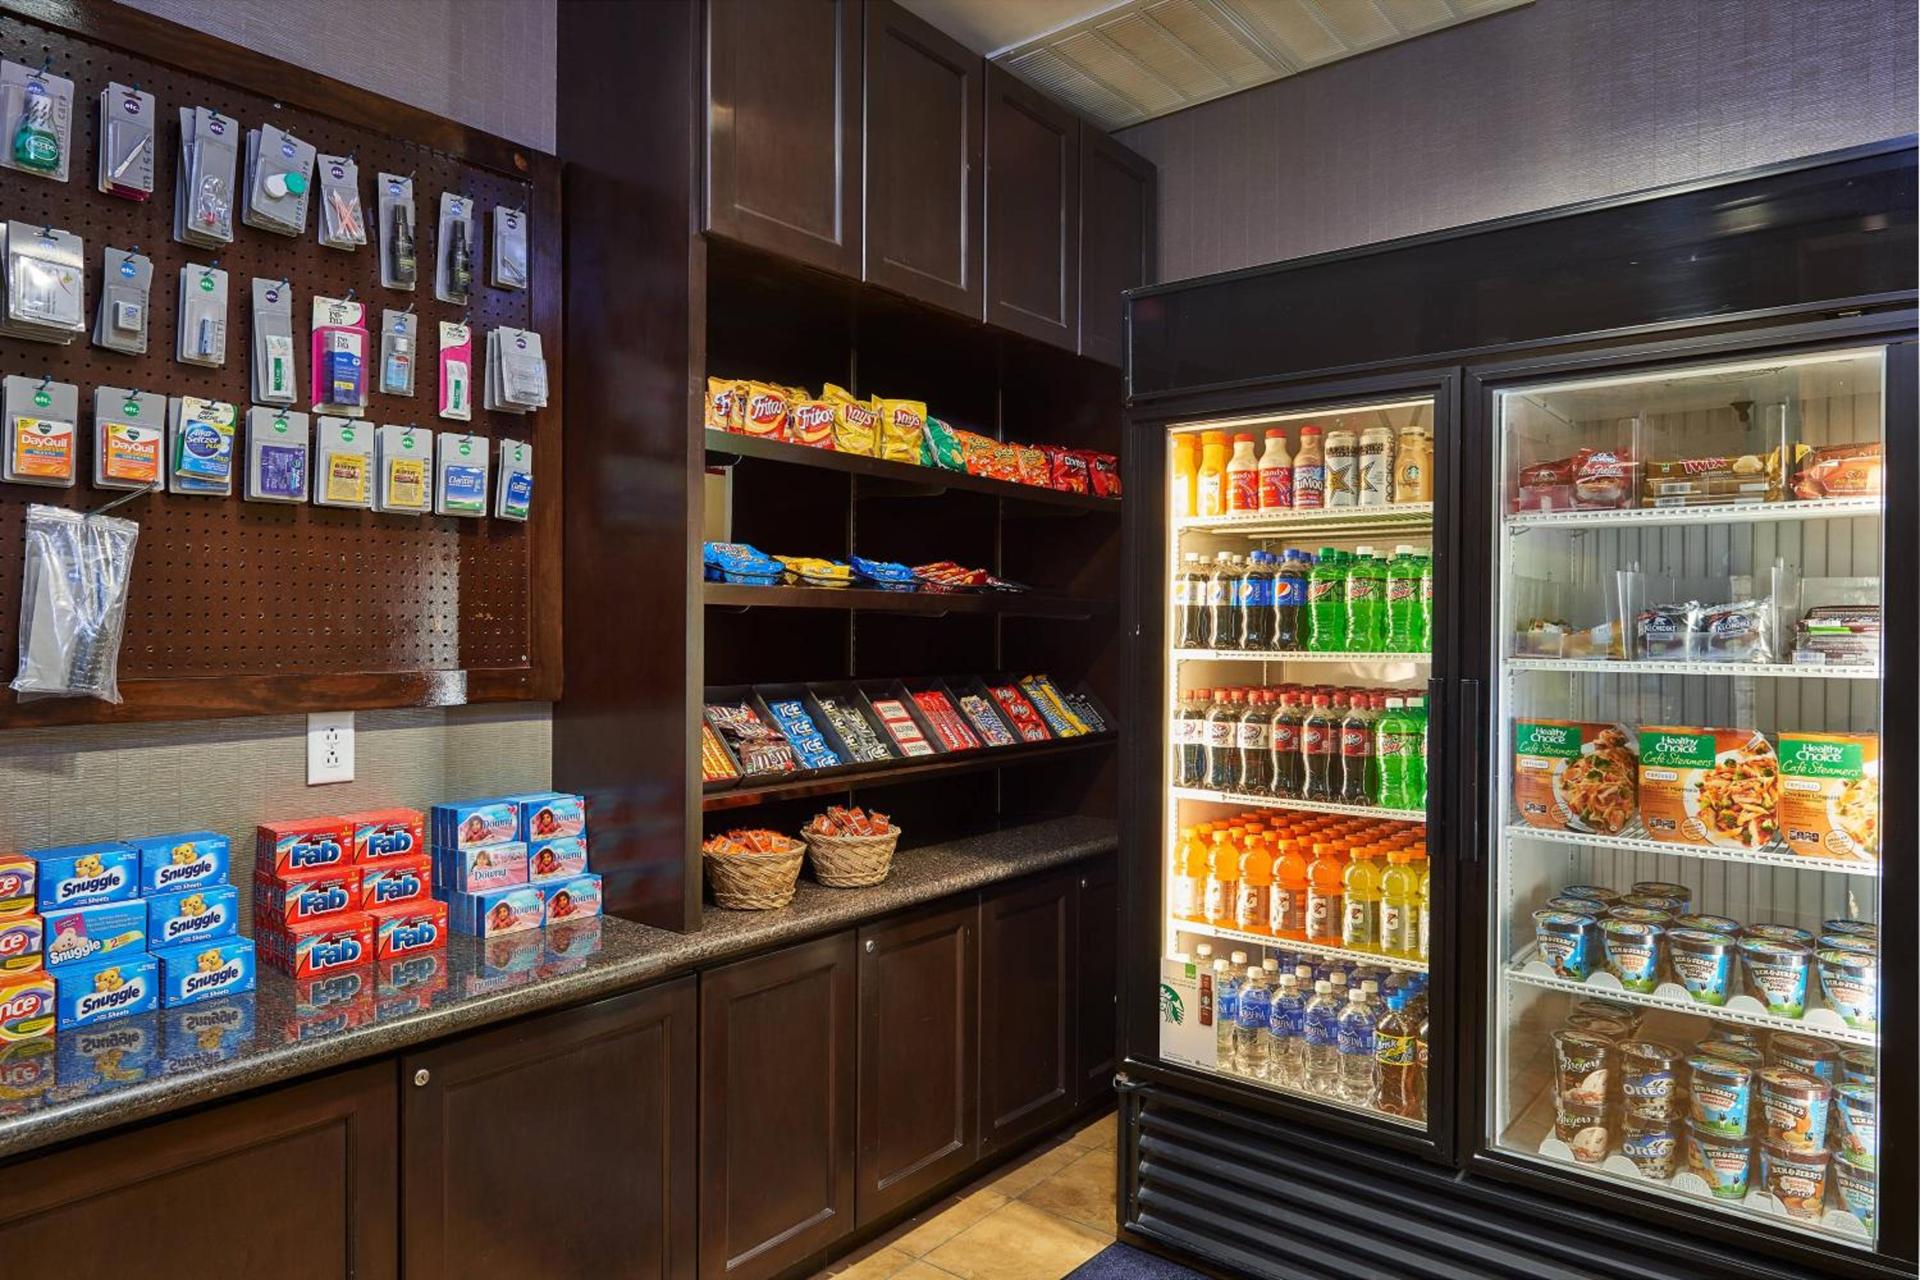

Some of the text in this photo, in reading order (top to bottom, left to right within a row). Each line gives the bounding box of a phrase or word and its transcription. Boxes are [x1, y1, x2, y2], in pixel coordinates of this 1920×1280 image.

[35, 395, 52, 404] etc.
[751, 394, 785, 420] Fritos
[124, 405, 140, 413] etc.
[796, 404, 834, 430] Fritos
[22, 435, 68, 448] DayQuil
[111, 440, 155, 454] DayQuil
[780, 704, 802, 718] ICE
[791, 721, 813, 735] ICE
[1535, 728, 1568, 738] Healthy
[802, 738, 825, 753] ICE
[1530, 733, 1566, 744] Choice
[1660, 735, 1699, 747] Healthy
[1655, 743, 1698, 754] Choice
[1802, 744, 1844, 755] Healthy
[1666, 752, 1714, 767] Steamers
[1796, 751, 1842, 762] Choice
[1808, 761, 1861, 777] Steamers
[367, 831, 413, 857] Fab
[290, 840, 342, 868] Fab
[159, 858, 212, 884] Snuggle
[61, 873, 121, 899] Snuggle
[376, 877, 421, 903] Fab
[299, 887, 349, 917] Fab
[168, 912, 221, 937] Snuggle
[391, 920, 437, 951] Fab
[49, 938, 102, 966] Snuggle
[310, 939, 362, 969] Fab
[186, 966, 239, 993] Snuggle
[81, 985, 141, 1015] Snuggle
[1559, 1057, 1601, 1073] Breyers
[1622, 1083, 1667, 1097] OREO
[1622, 1143, 1668, 1156] OREO
